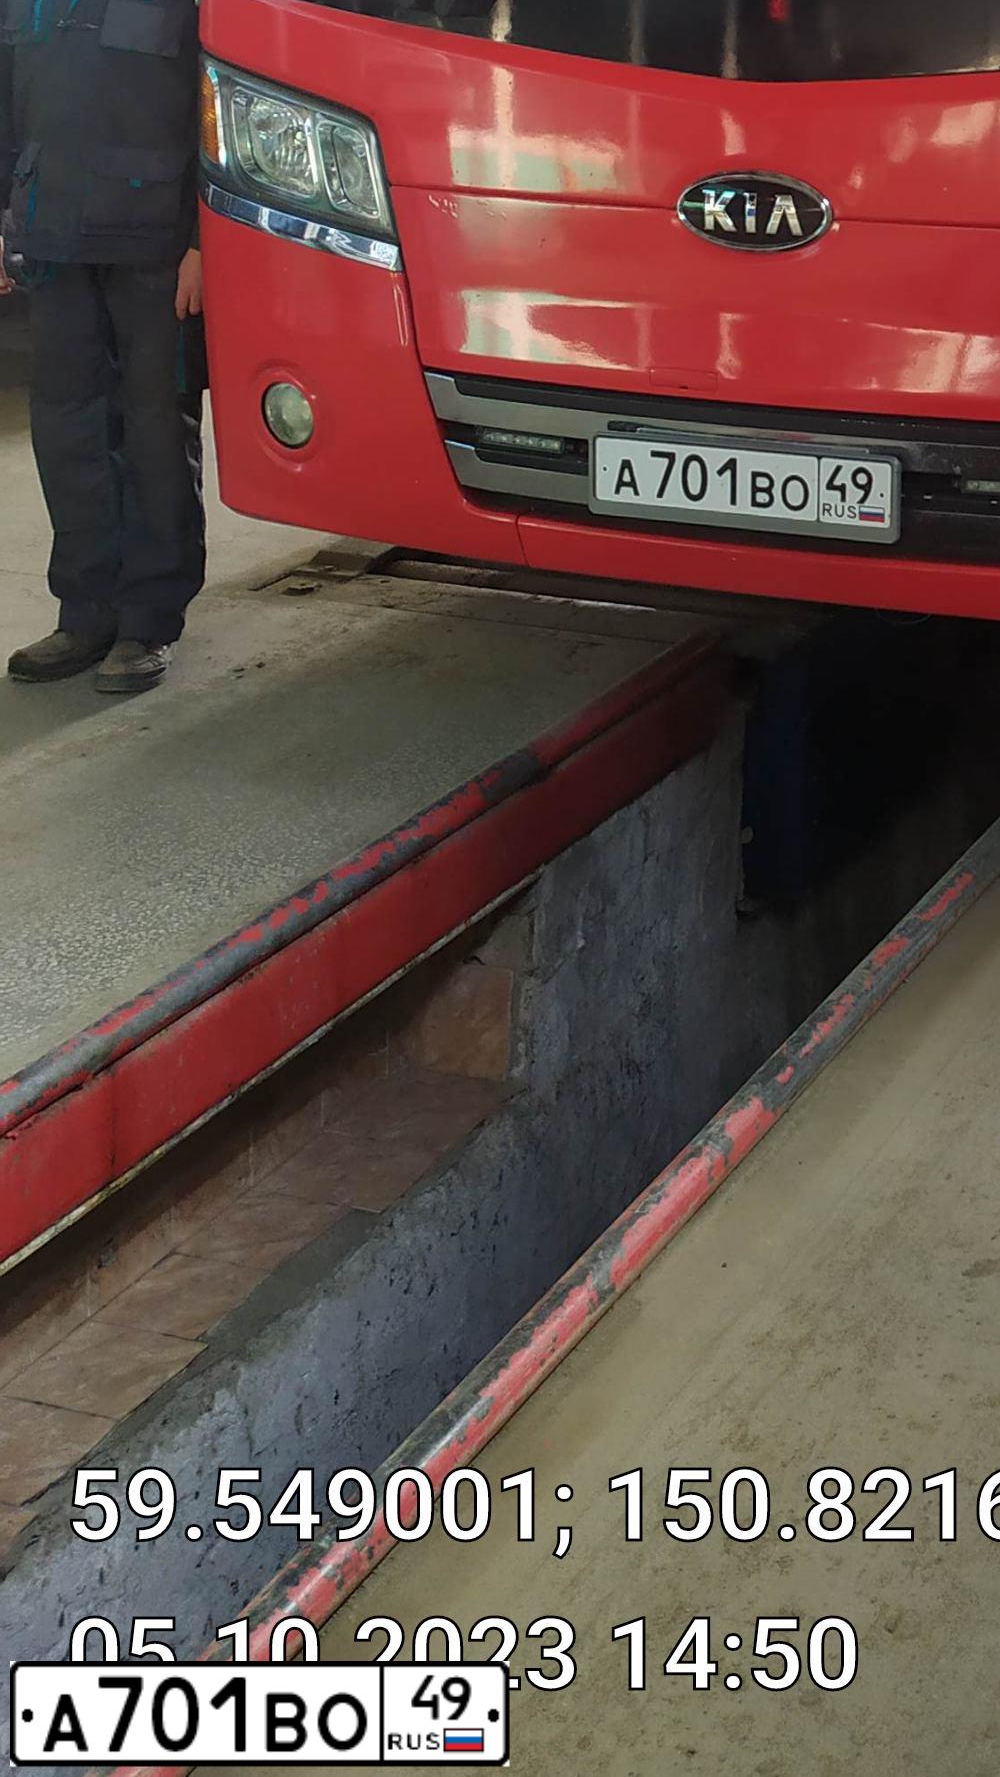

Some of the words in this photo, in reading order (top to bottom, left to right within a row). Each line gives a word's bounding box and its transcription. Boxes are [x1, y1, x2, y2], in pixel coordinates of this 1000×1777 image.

[701, 188, 803, 236] KIA
[825, 464, 874, 505] 49
[821, 503, 857, 519] RUS
